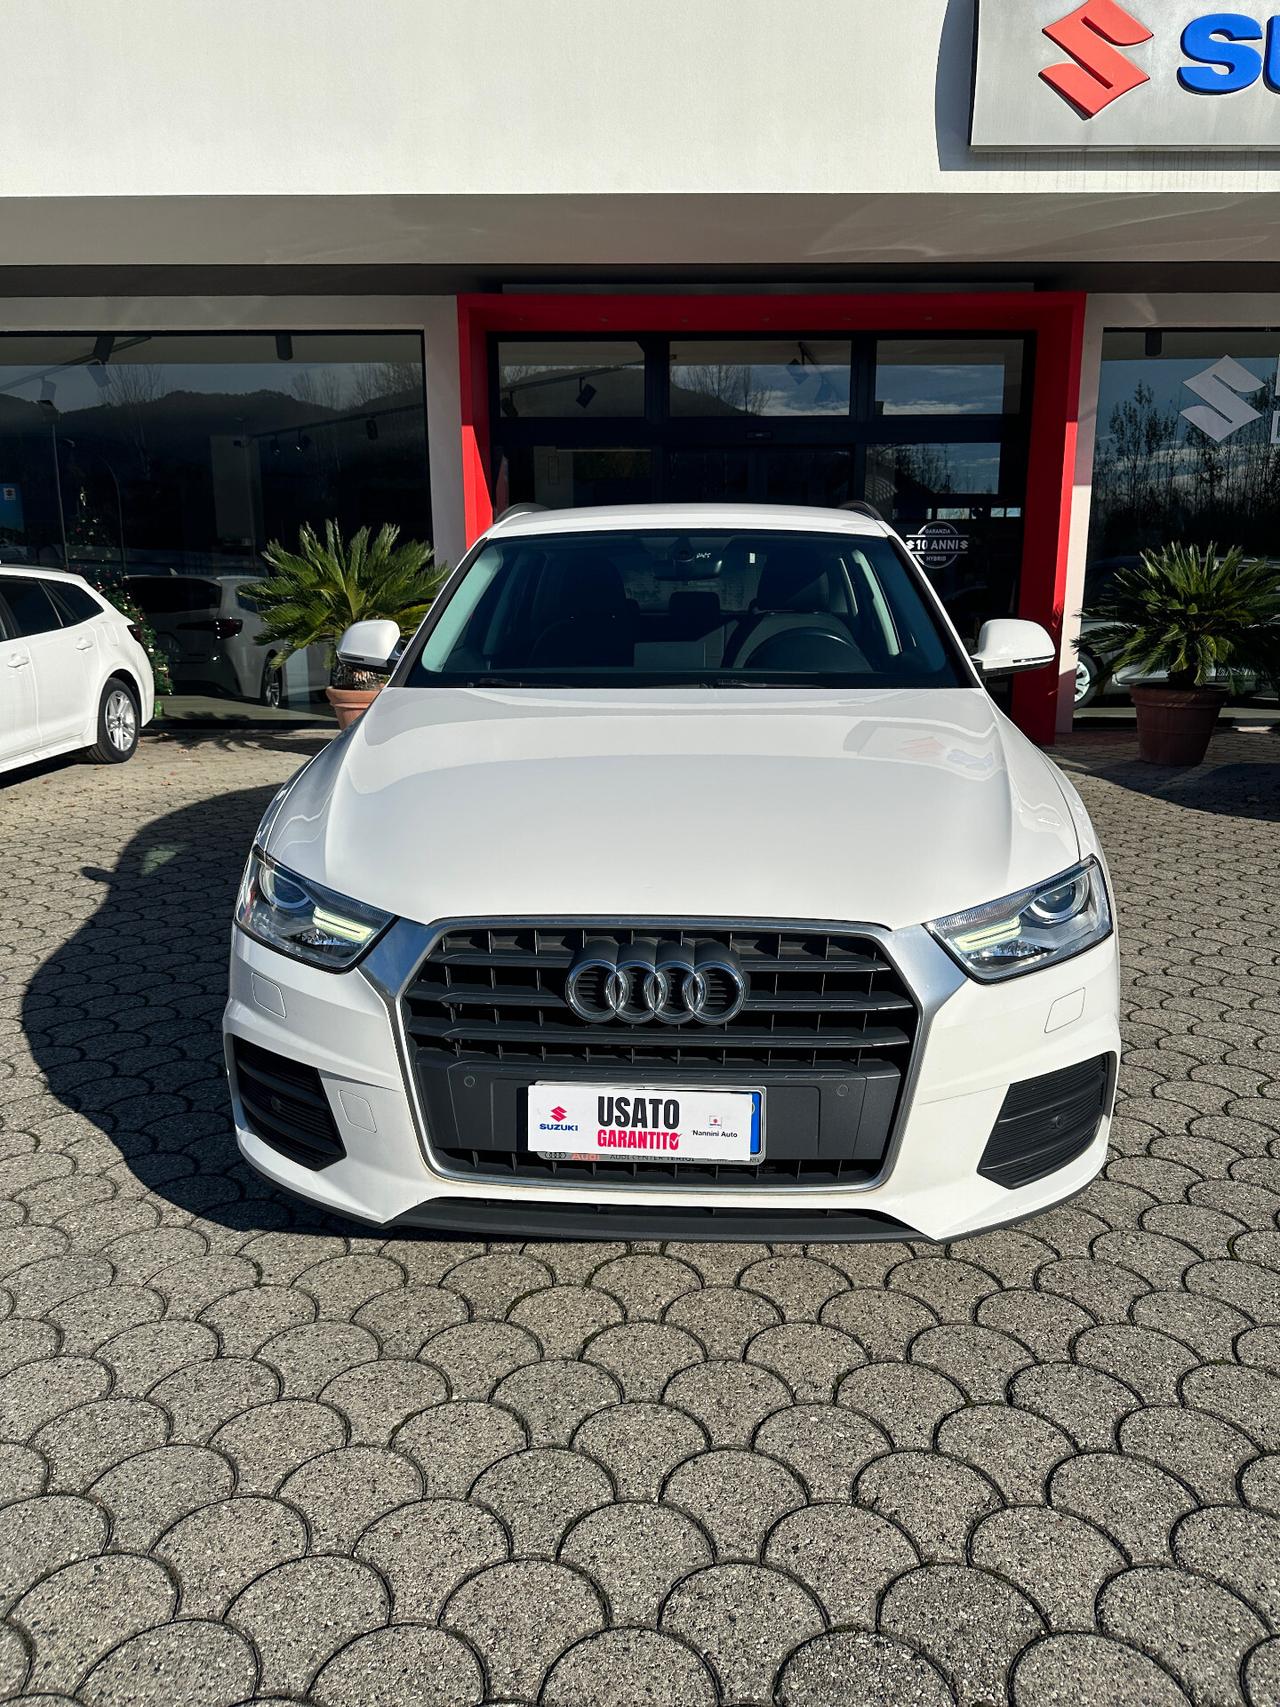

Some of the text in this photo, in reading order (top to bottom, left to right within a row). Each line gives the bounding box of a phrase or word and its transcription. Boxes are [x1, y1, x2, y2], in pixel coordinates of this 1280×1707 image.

[1177, 13, 1280, 95] S
[916, 539, 959, 550] 10 ANNI
[597, 1096, 680, 1130] USATO
[539, 1123, 579, 1131] SUZUKI
[597, 1129, 680, 1150] GARANTITO
